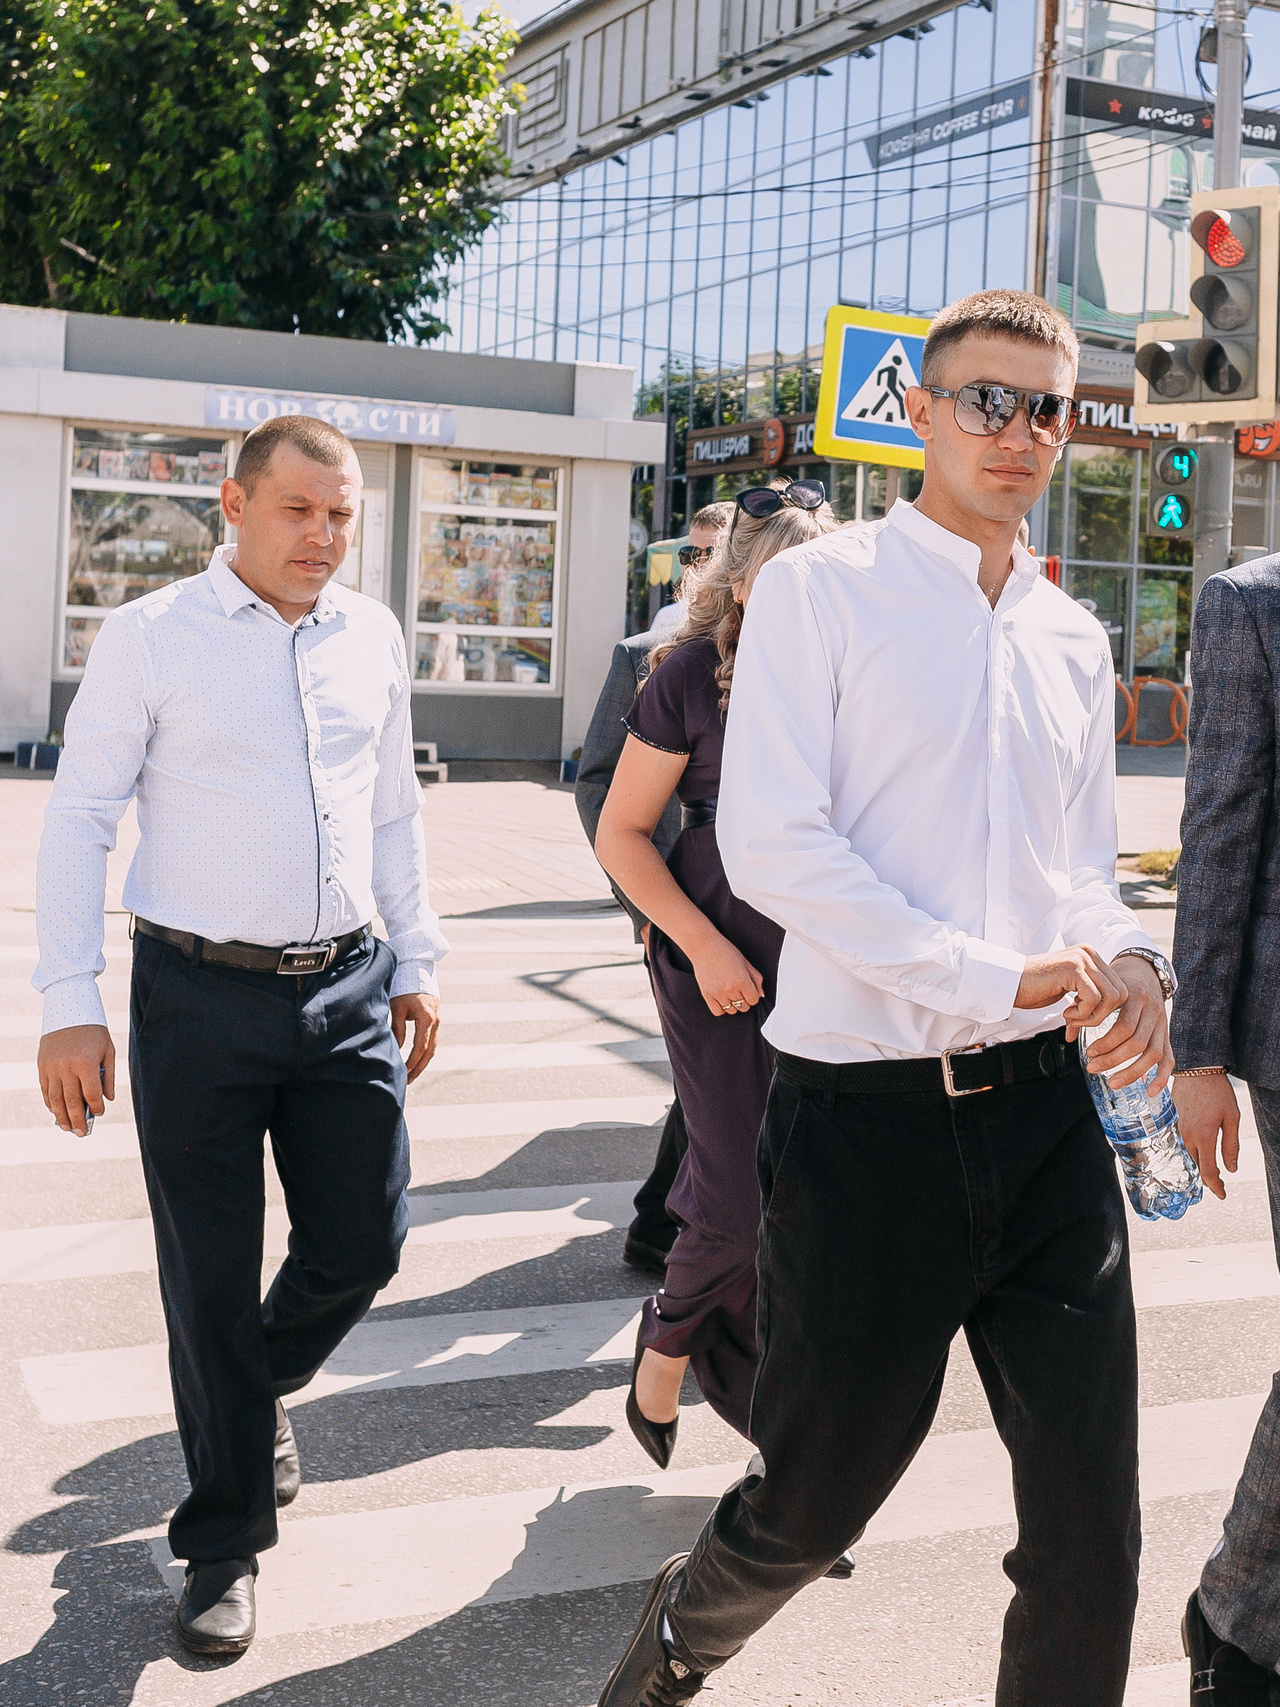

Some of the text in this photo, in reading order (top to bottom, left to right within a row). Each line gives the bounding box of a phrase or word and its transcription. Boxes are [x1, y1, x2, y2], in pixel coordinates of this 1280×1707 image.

[931, 98, 1015, 142] COFFEE STAR
[1241, 123, 1277, 142] чай
[693, 434, 750, 463] ПИЦЦЕРИЯ
[1173, 454, 1190, 479] 4
